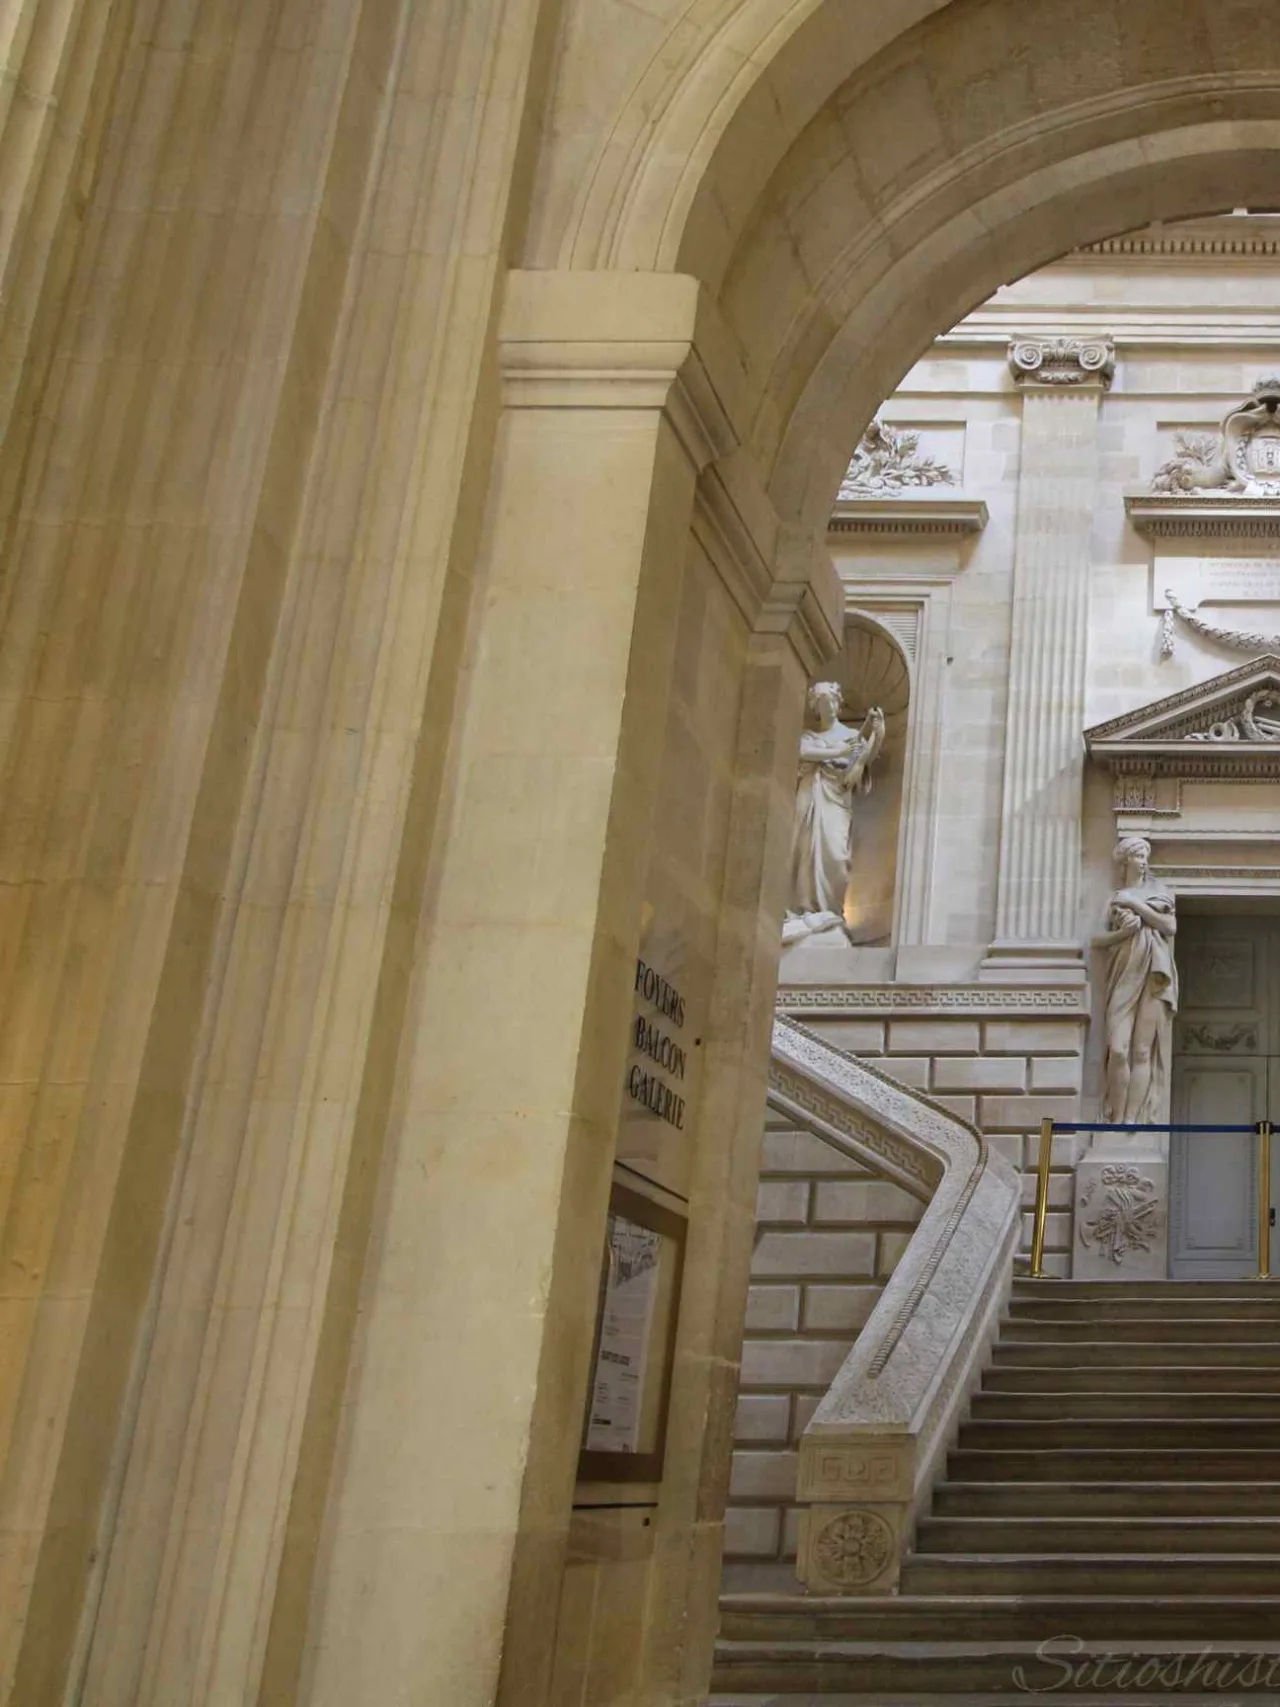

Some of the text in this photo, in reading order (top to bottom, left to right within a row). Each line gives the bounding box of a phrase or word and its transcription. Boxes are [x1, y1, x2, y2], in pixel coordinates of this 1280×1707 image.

[634, 959, 686, 1028] FOYERS
[635, 1015, 687, 1081] BALCON
[630, 1065, 686, 1131] GALERIE
